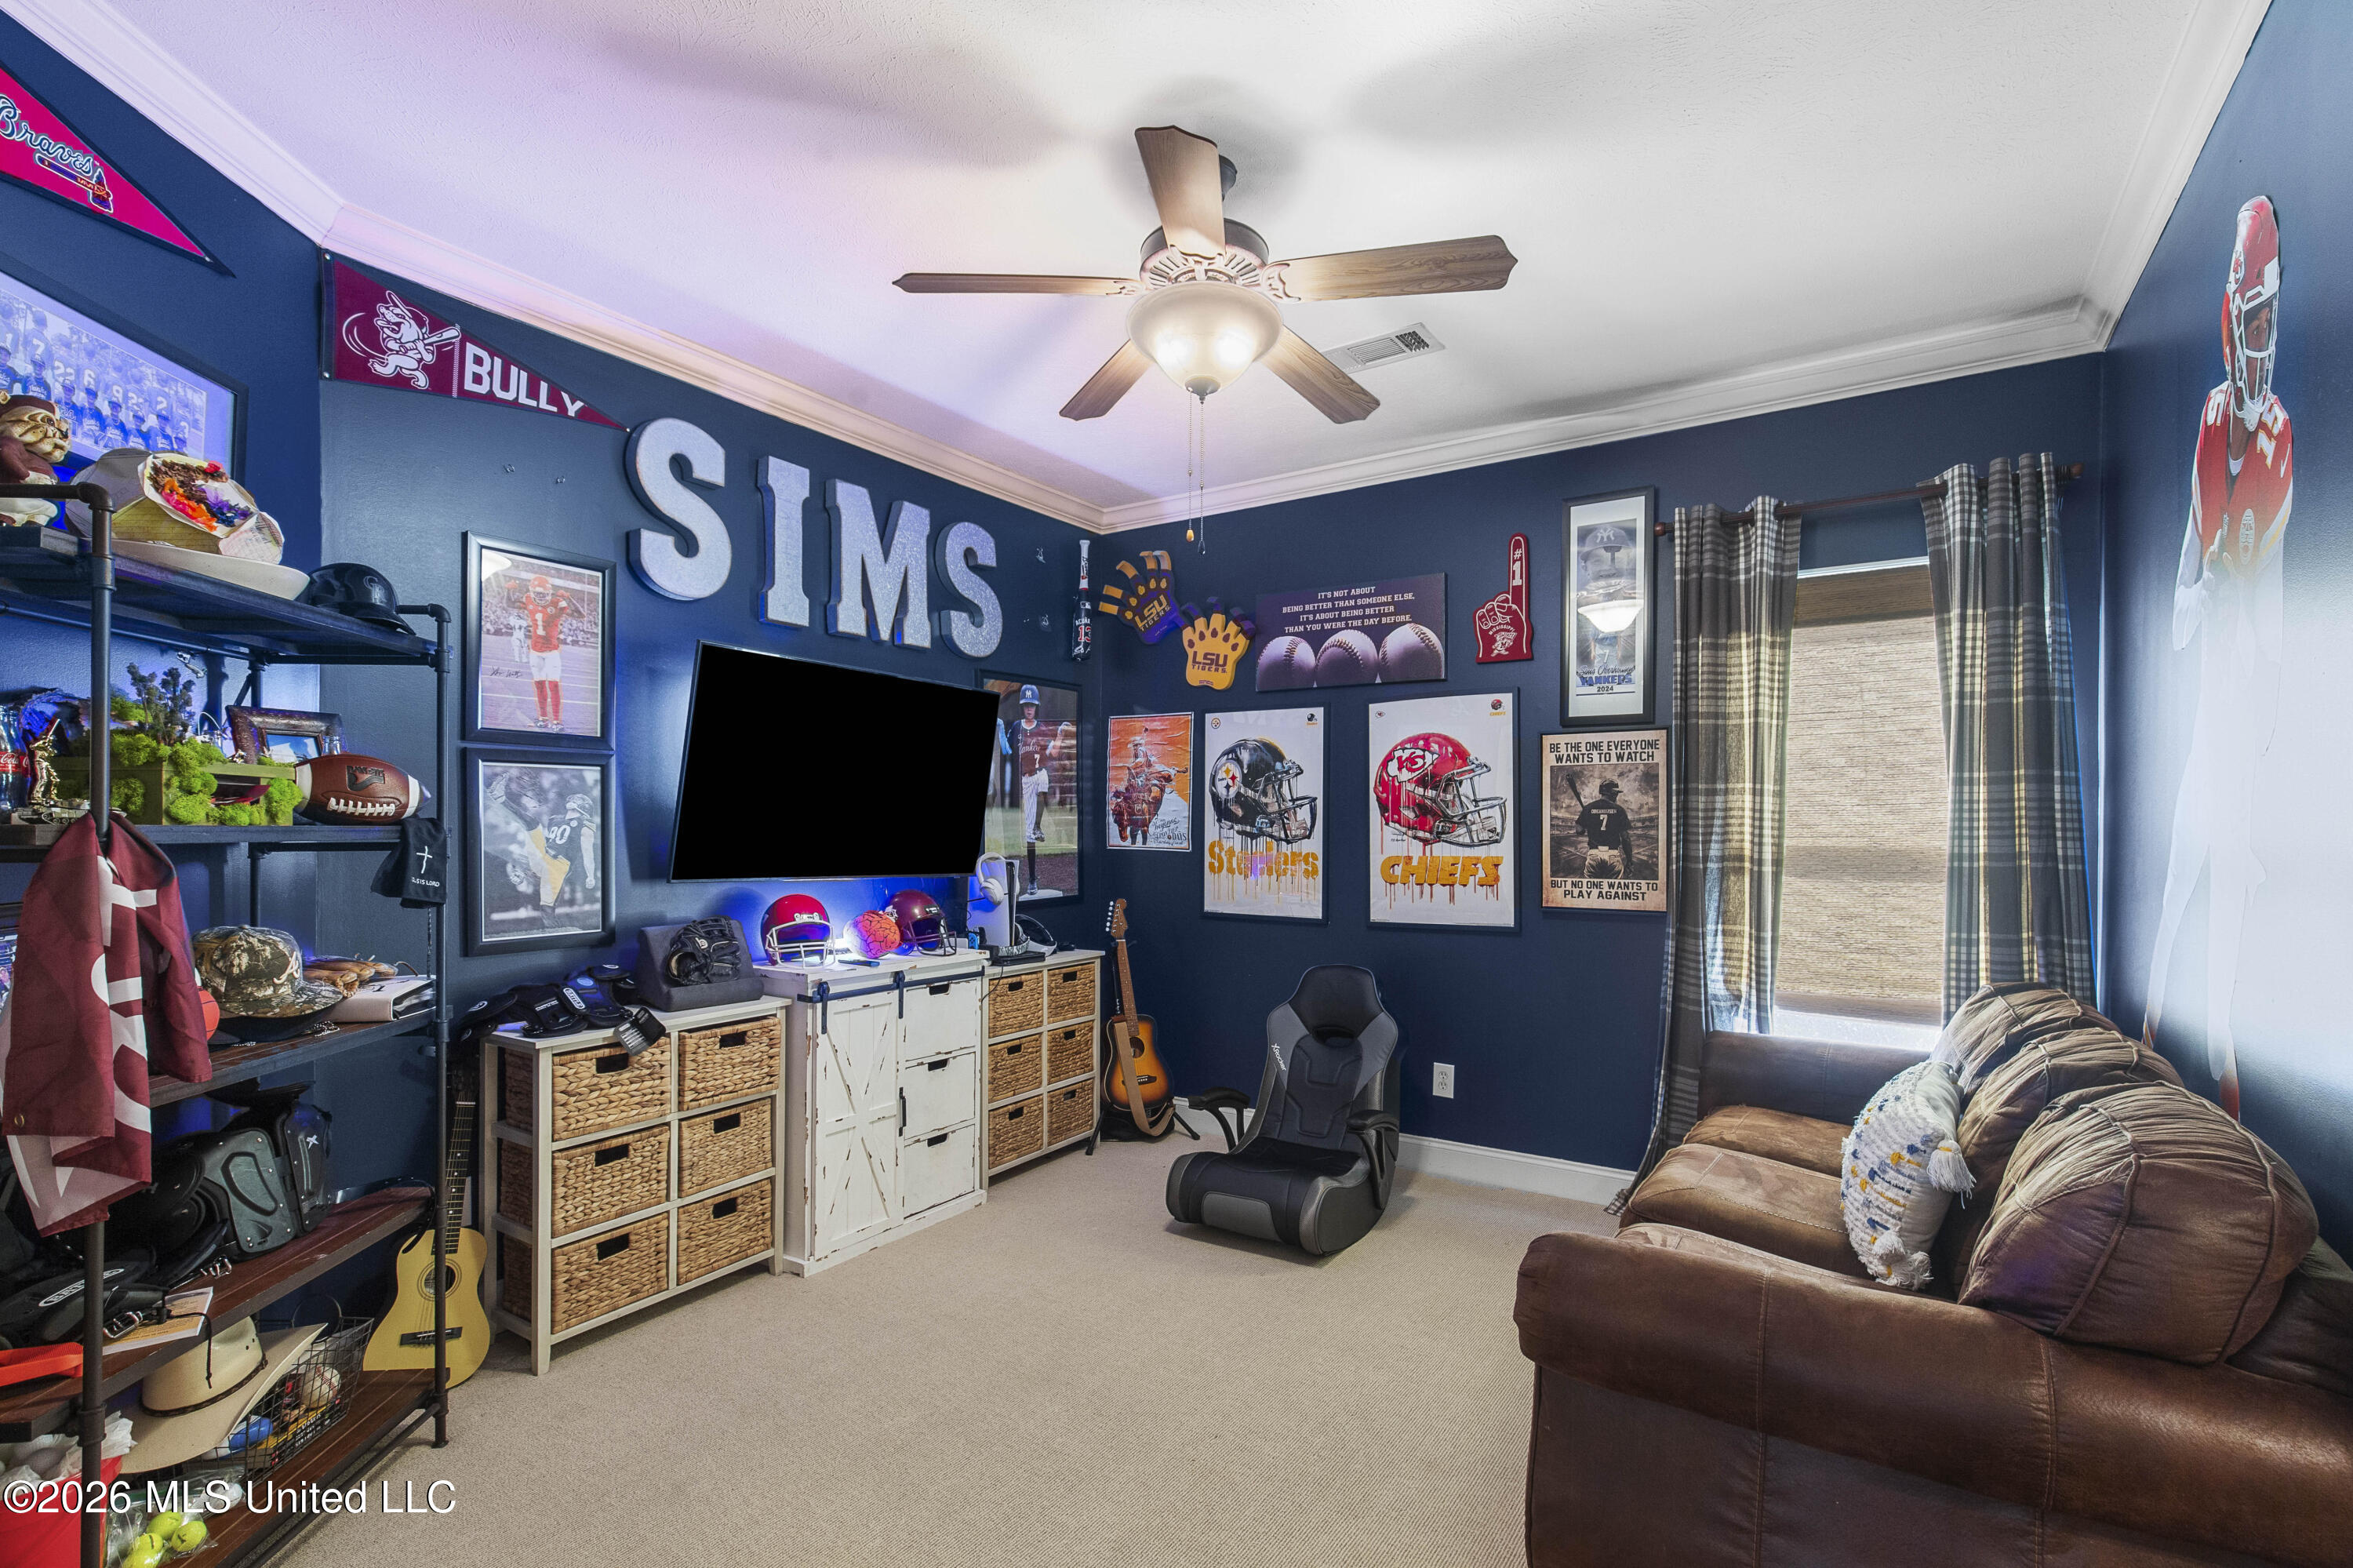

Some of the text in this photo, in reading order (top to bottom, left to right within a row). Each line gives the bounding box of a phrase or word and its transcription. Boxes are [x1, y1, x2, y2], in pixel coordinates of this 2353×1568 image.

[0, 93, 93, 176] Braves
[464, 342, 584, 417] BULLY
[625, 417, 1003, 658] SIMS
[1512, 560, 1522, 586] 1
[1351, 587, 1376, 595] ABOUT
[1282, 592, 1415, 613] BEING BETTER THAN SOMEONE ELSE,
[1135, 595, 1168, 628] LSU
[1341, 609, 1363, 617] BEING
[1365, 606, 1395, 615] BETTER
[534, 613, 546, 636] 1
[1323, 621, 1346, 630] WERE
[1381, 614, 1413, 624] BEFORE.
[1191, 650, 1228, 668] LSU
[1603, 649, 1609, 664] 7
[1549, 739, 1660, 754] BE THE ONE EVERYONE
[1035, 754, 1040, 768] 7
[1555, 751, 1655, 764] WANTS TO WATCH
[1599, 814, 1608, 831] 7
[1208, 840, 1319, 879] Steelers
[1380, 855, 1504, 887] CHIEFS
[1551, 879, 1658, 891] BUT NO ONE WANTS TO
[1563, 890, 1647, 901] PLAY AGAINST
